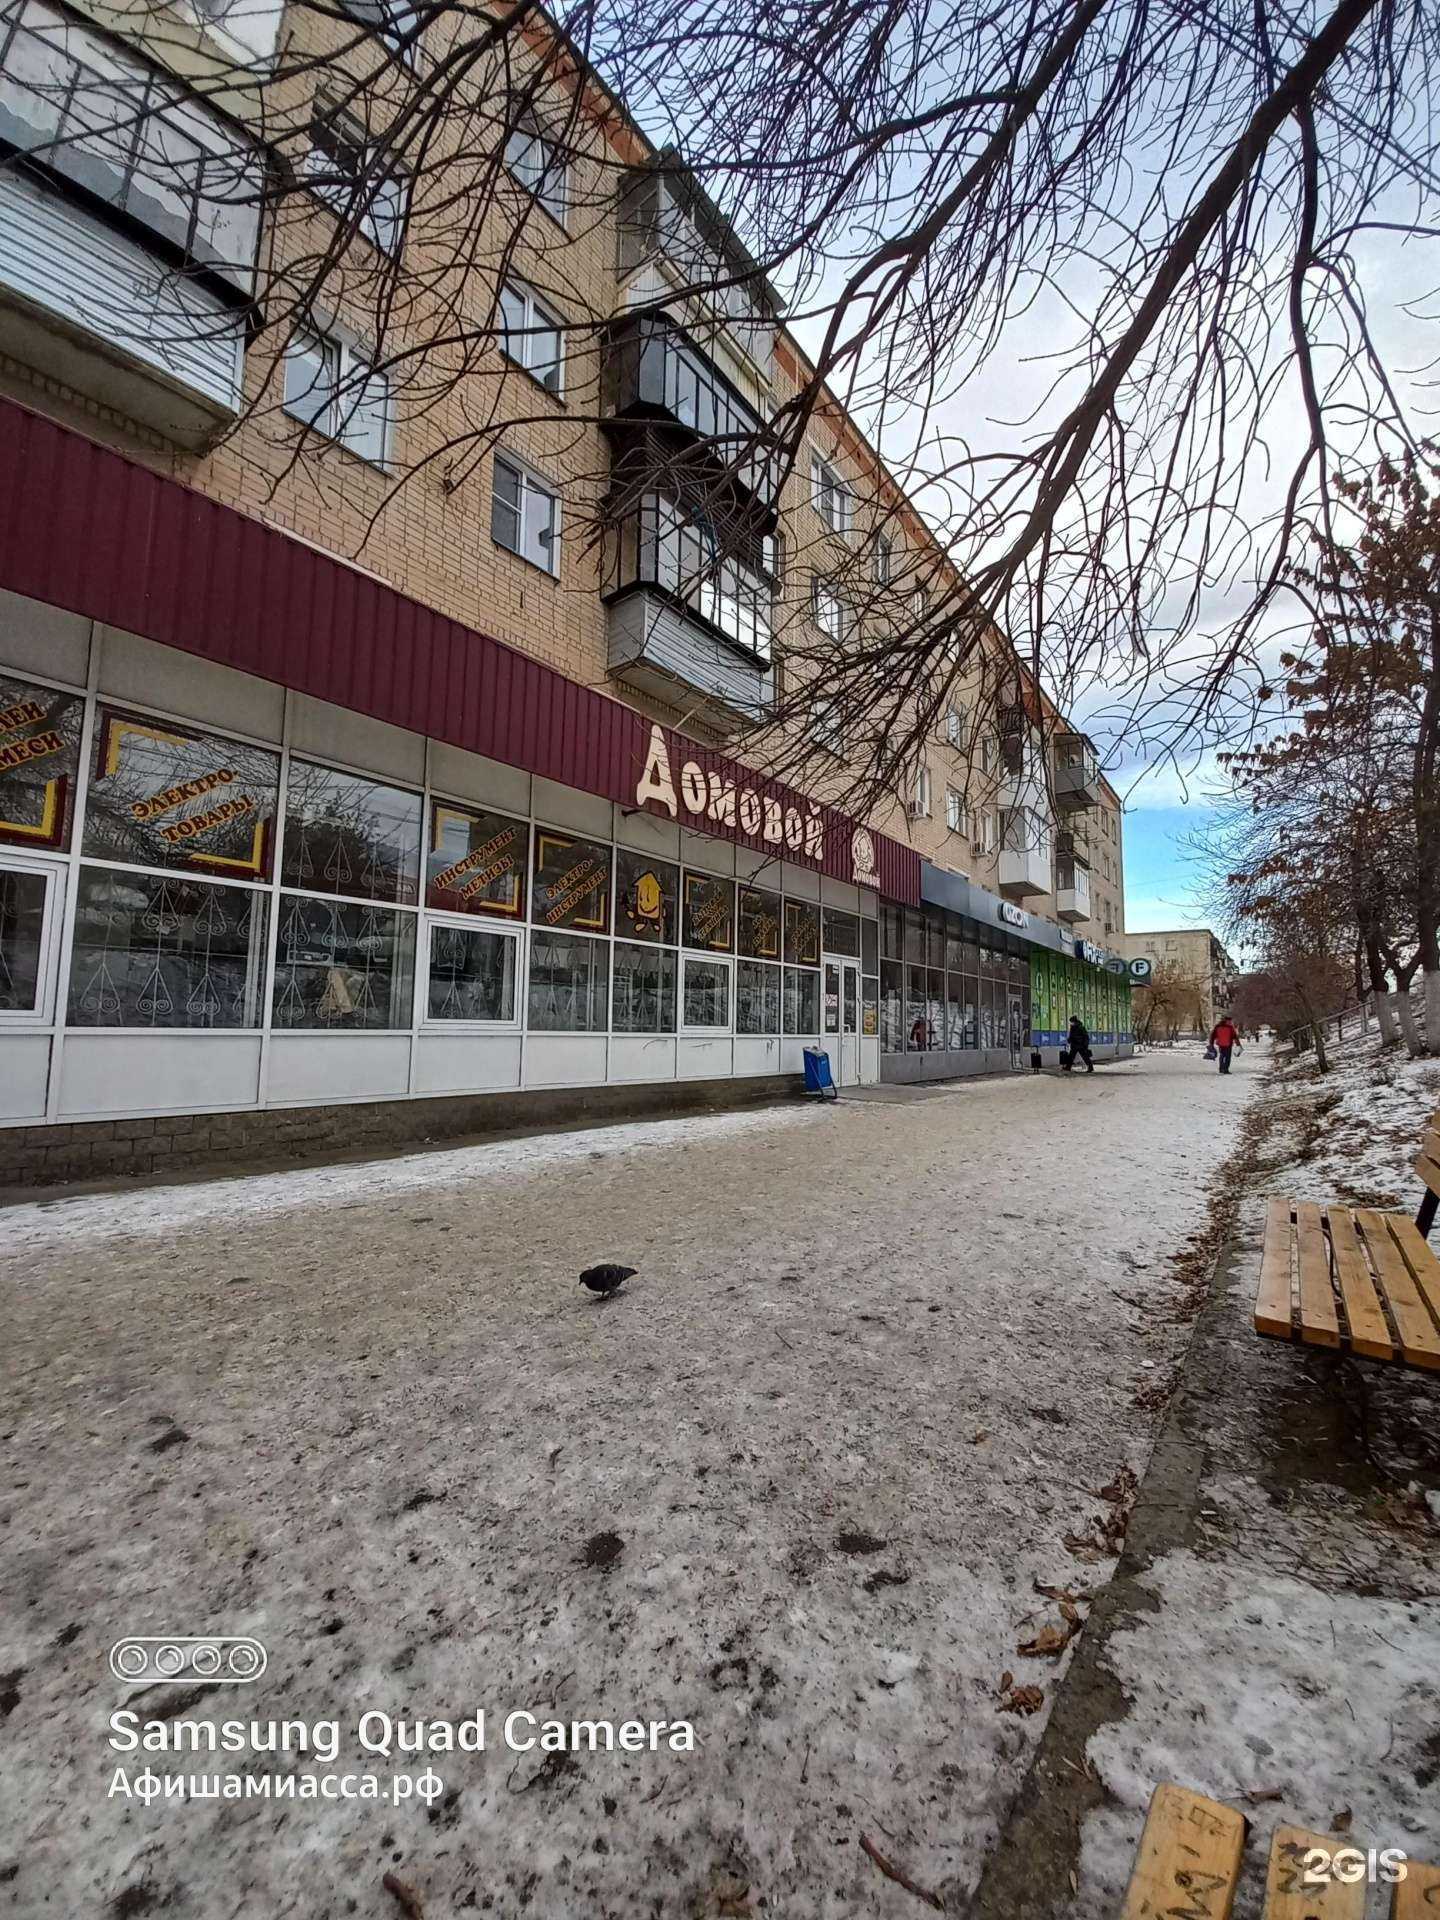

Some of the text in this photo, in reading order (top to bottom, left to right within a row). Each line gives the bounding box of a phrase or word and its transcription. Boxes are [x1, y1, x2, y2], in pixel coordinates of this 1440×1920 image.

[130, 768, 239, 819] ЭЛЕКТРО-
[160, 793, 255, 844] ТОВАРЫ
[434, 826, 518, 889] ИНСТРУМЕНТ
[459, 853, 514, 900] МЕТИЗЫ
[546, 866, 607, 924] ИНСТРУМЕНТ
